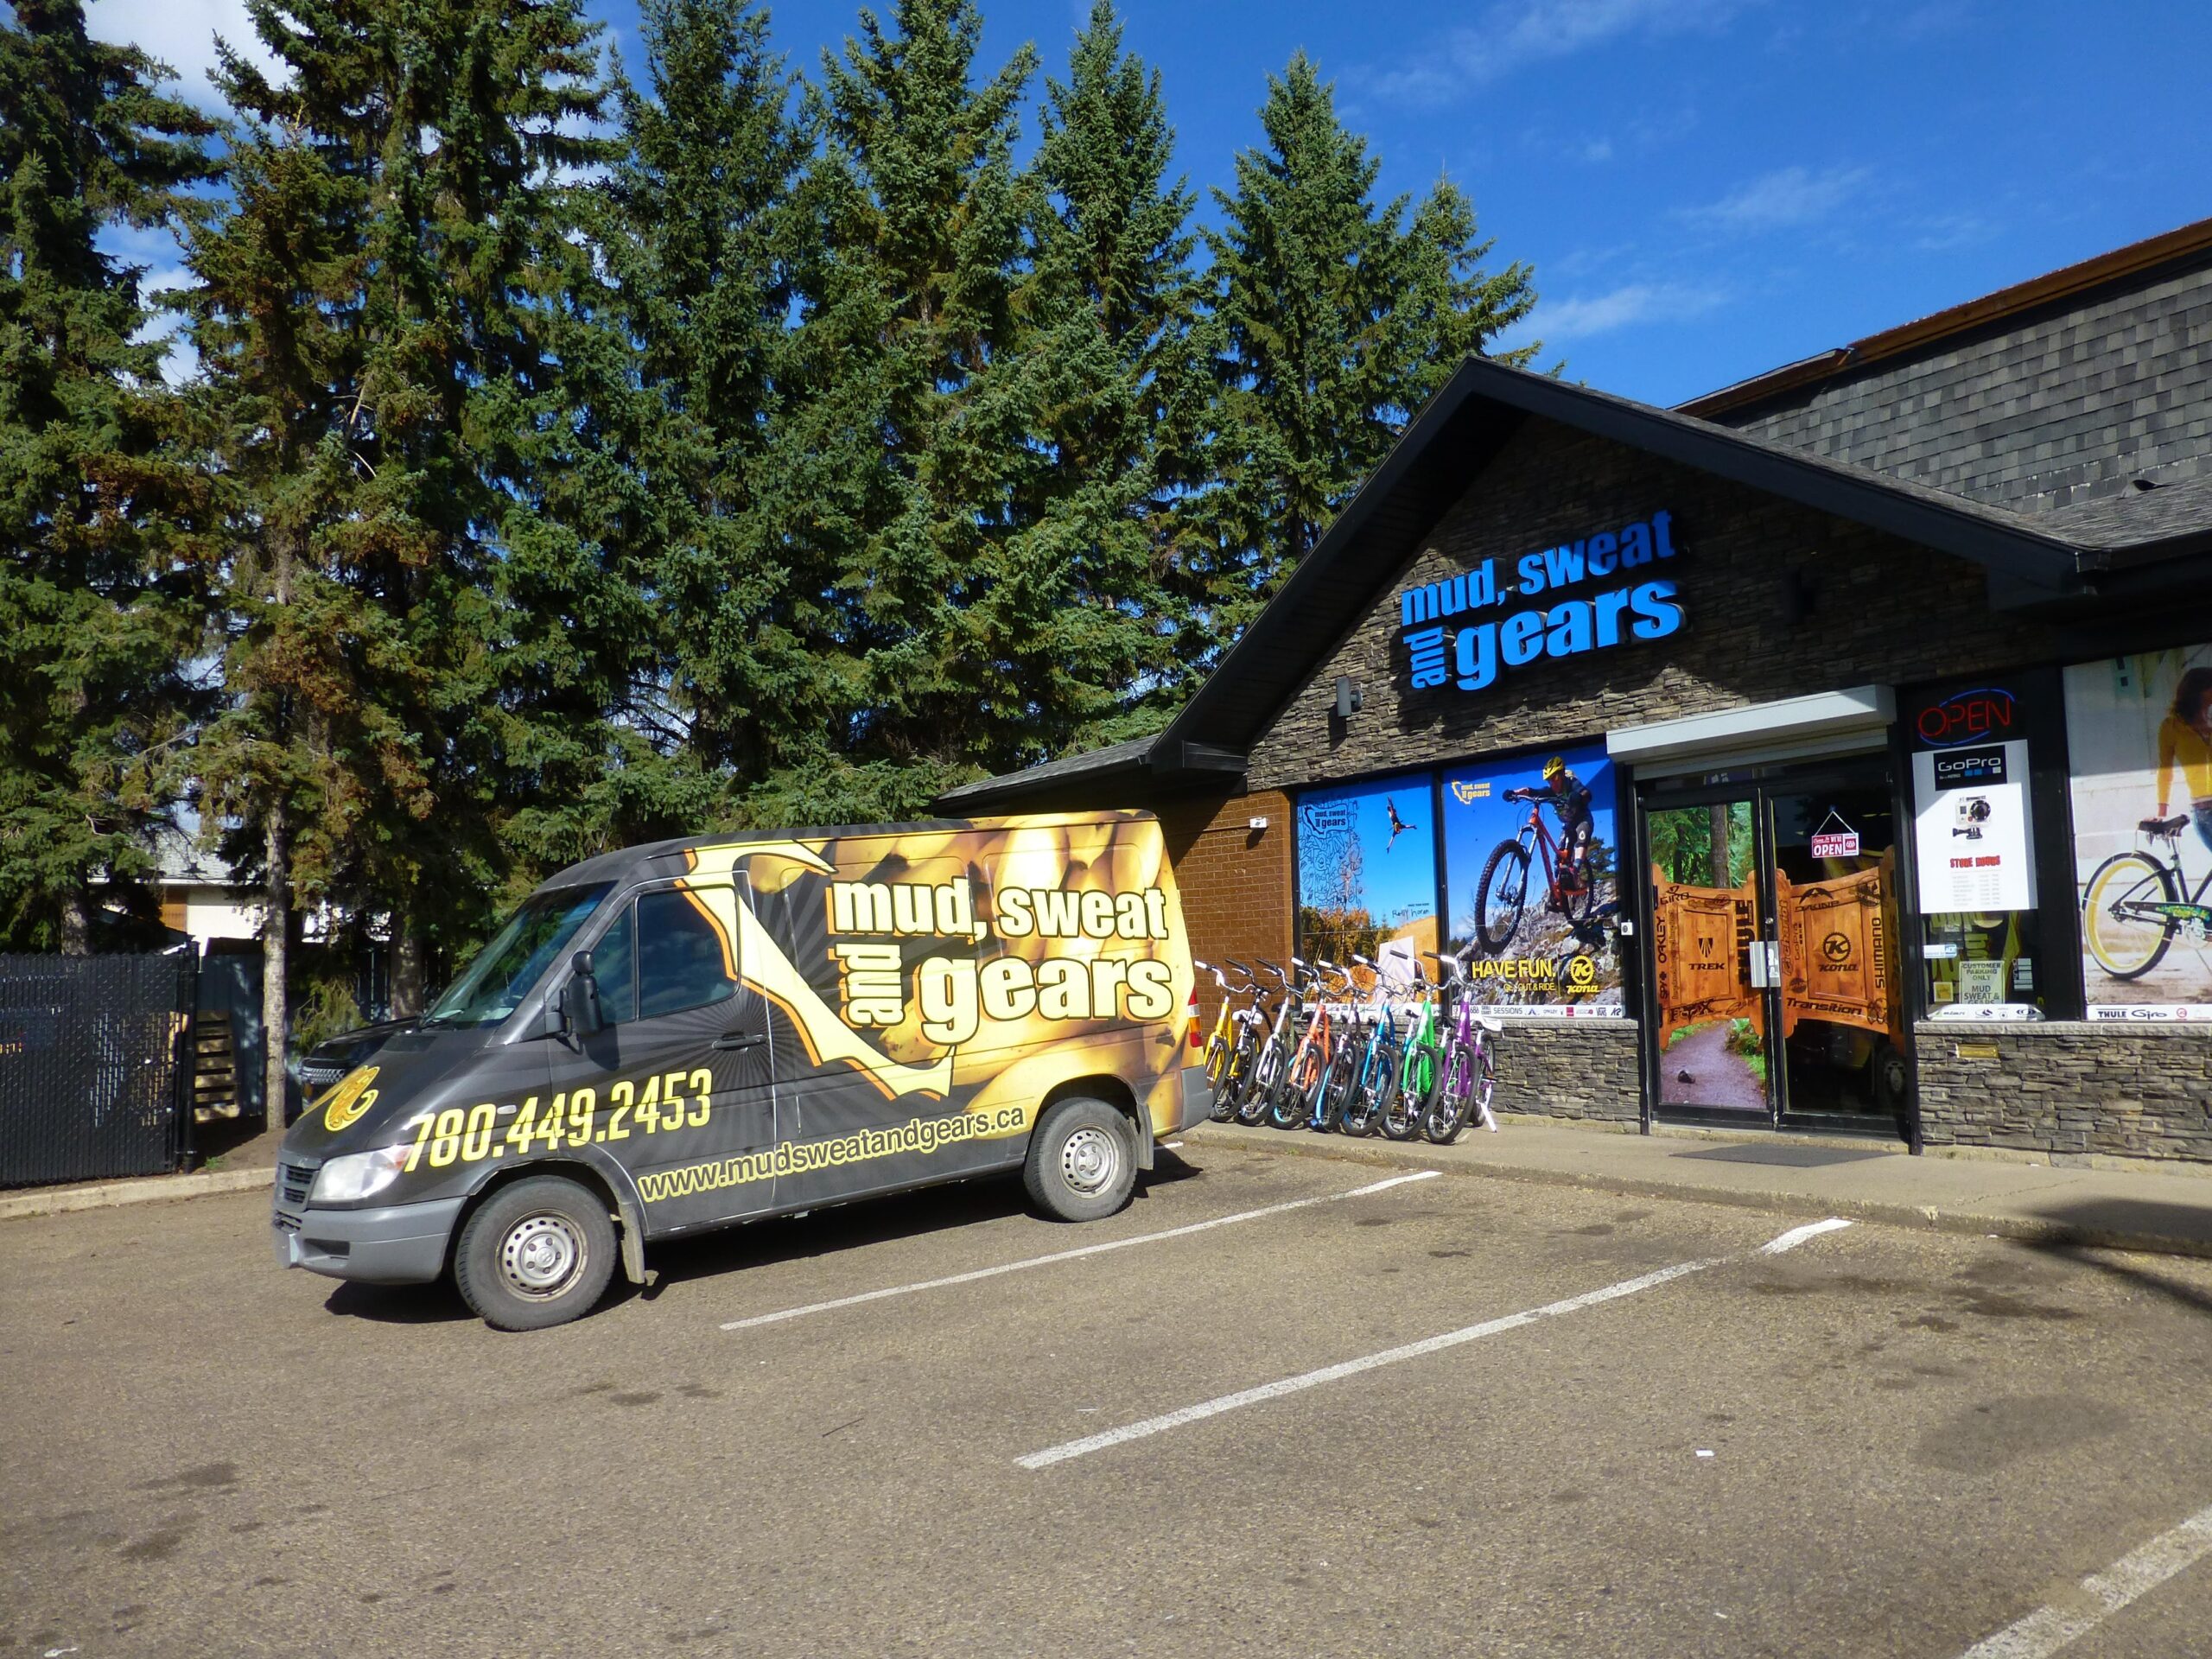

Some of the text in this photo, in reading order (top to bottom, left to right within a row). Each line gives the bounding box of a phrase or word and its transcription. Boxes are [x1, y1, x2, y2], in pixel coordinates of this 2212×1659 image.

[1402, 509, 1675, 626] mud, sweat
[1403, 626, 1447, 689] and
[1457, 580, 1682, 690] gears
[1918, 696, 2011, 736] OPEN
[1938, 758, 2001, 772] GoPro
[1321, 818, 1346, 829] gears
[1814, 843, 1842, 855] OPEN
[831, 878, 1168, 941] mud, sweat
[1656, 917, 1667, 963] OAKLEY
[1471, 958, 1556, 978] HAVE FUN.
[1872, 917, 1885, 988] SHIMANO
[835, 943, 905, 1027] and
[918, 956, 1173, 1046] gears
[1786, 997, 1862, 1015] Transition
[2132, 1009, 2167, 1020] Giro
[404, 1068, 713, 1173] 780.449.2453
[637, 1105, 1026, 1203] www.mudsweatandgears.ca
